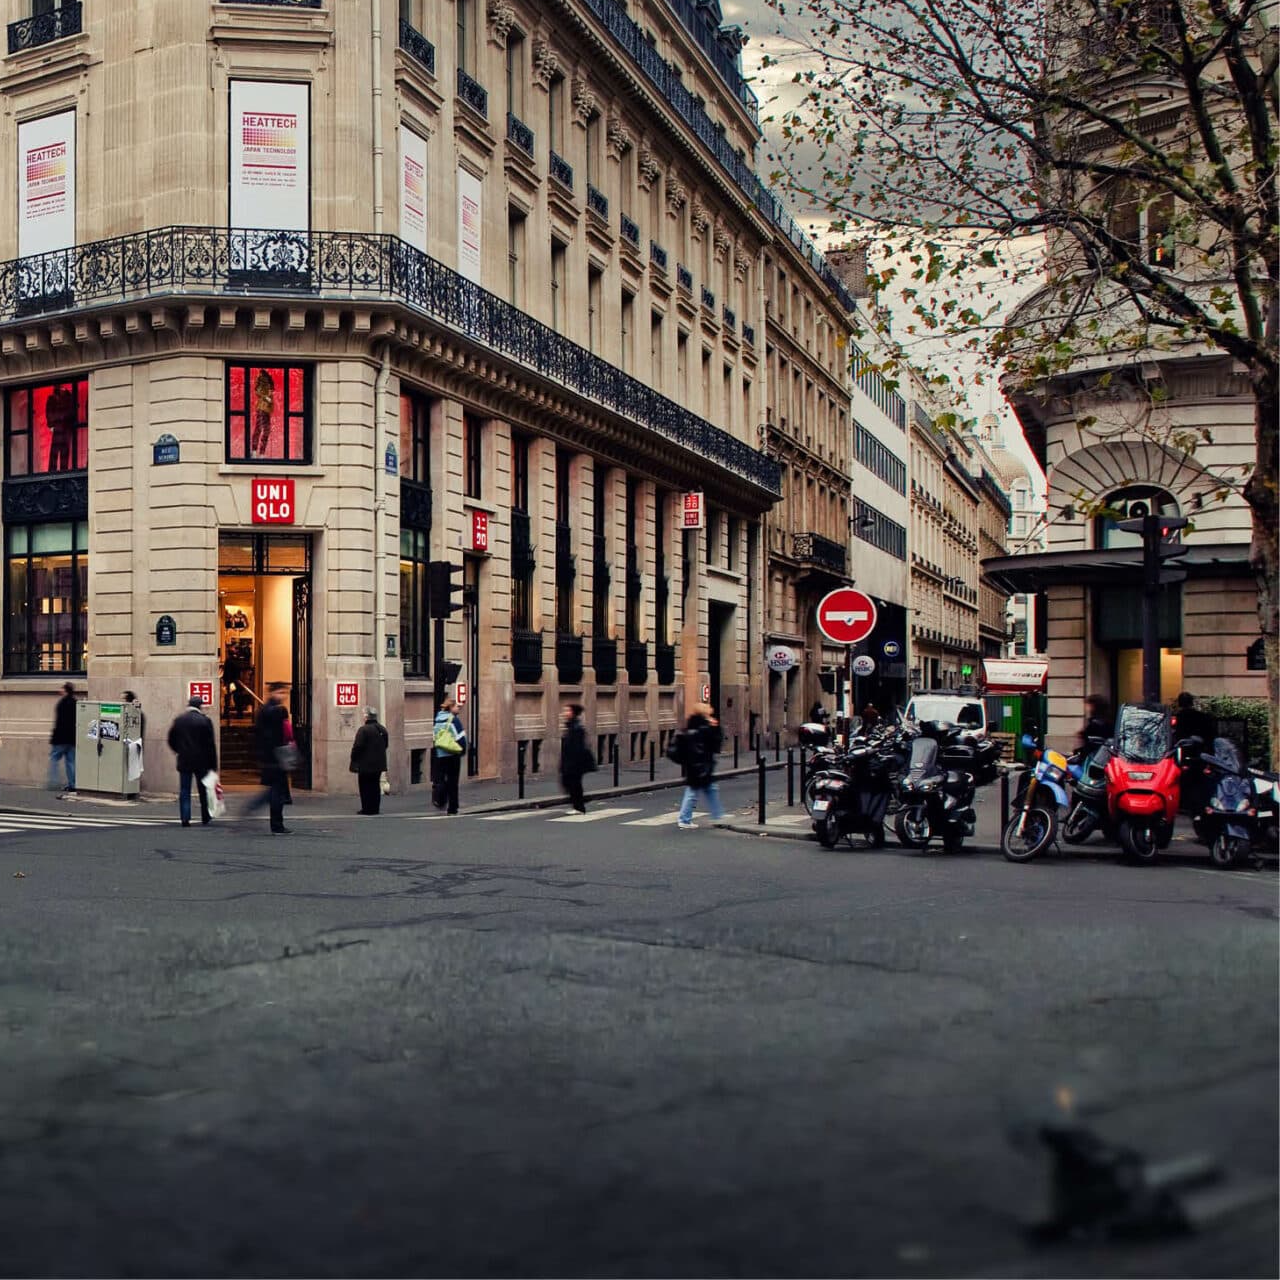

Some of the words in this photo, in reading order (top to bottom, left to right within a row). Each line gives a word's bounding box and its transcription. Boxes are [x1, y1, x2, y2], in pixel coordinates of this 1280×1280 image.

[242, 116, 297, 128] HEATTECH
[26, 146, 66, 164] HEATTECH
[257, 484, 287, 500] UNI
[257, 502, 290, 521] QLO
[339, 686, 355, 694] UNI
[339, 694, 356, 704] QLO
